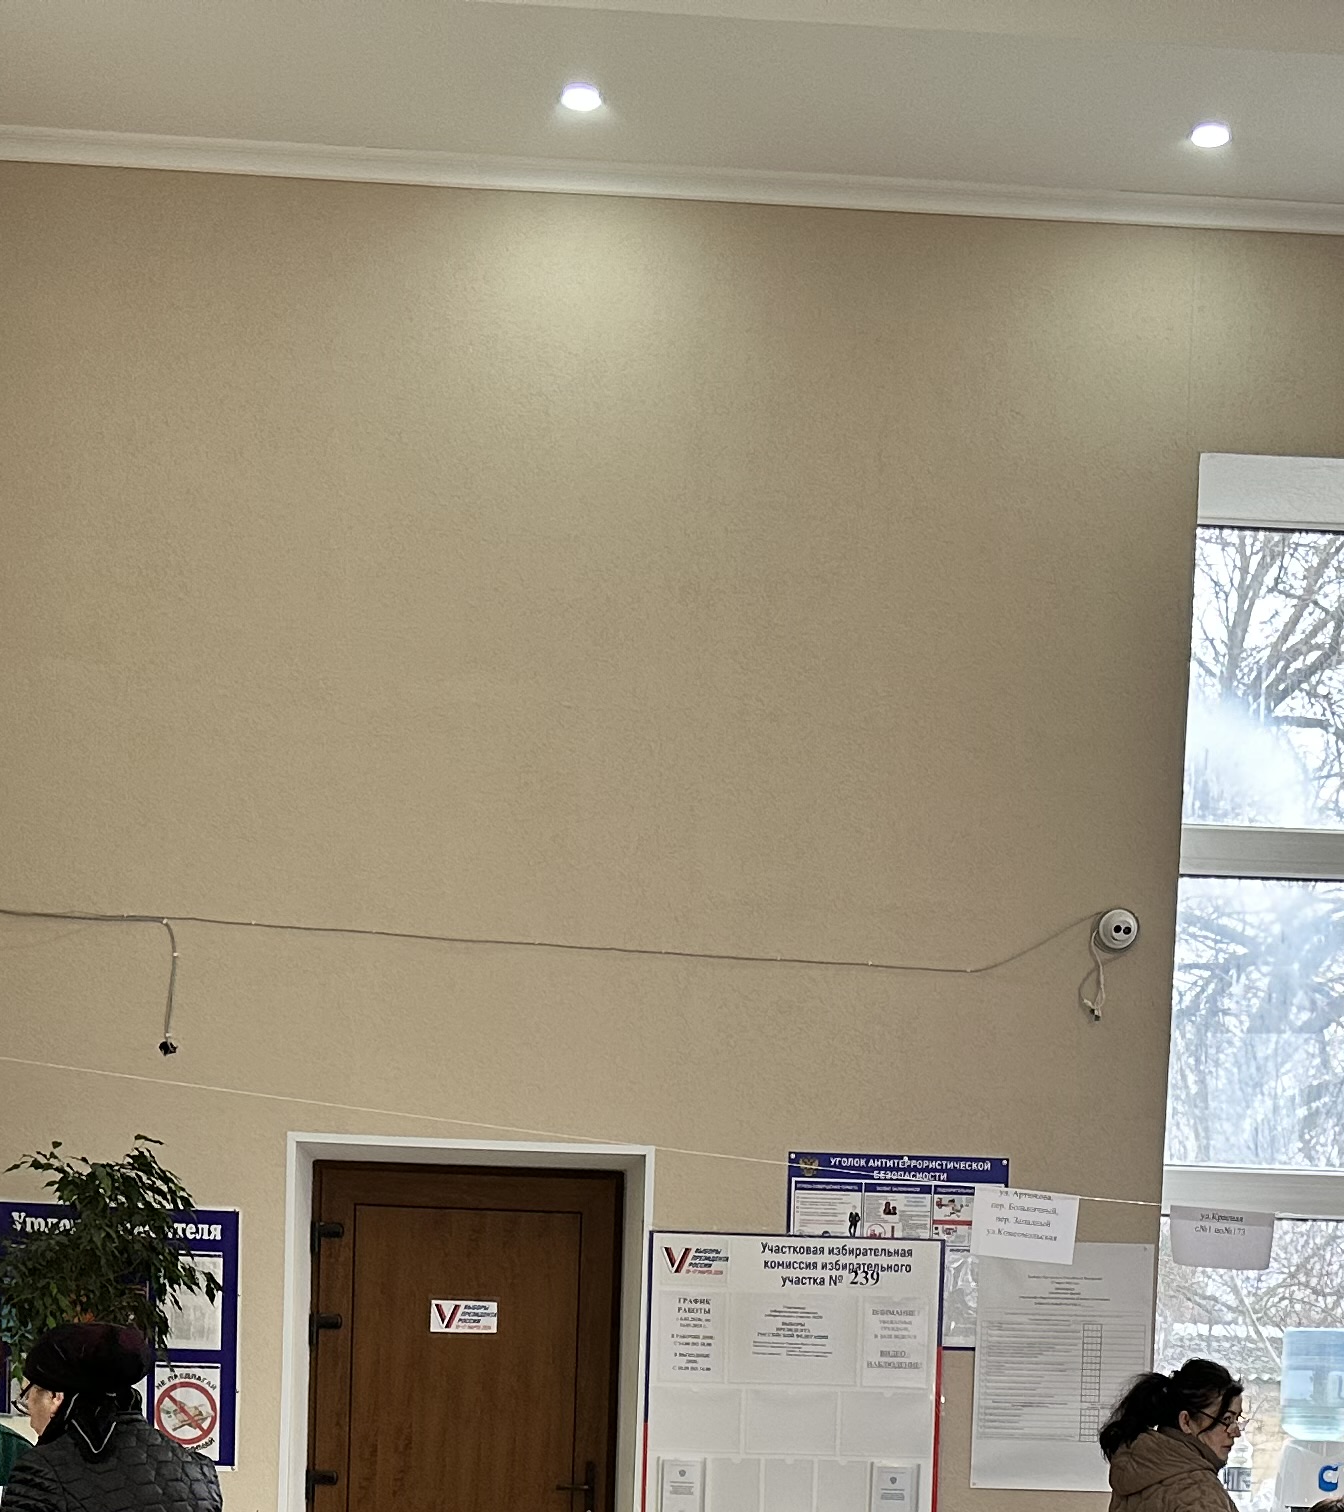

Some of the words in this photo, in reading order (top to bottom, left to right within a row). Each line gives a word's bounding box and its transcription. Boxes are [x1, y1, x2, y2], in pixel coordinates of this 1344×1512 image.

[829, 1157, 867, 1168] УГОЛОК
[868, 1158, 991, 1171] АНТИТЕРРОРИСТИЧЕСКОЙ
[760, 1241, 825, 1254] Участковая
[827, 1244, 913, 1259] избирательная
[763, 1259, 818, 1271] комиссия
[821, 1259, 912, 1274] избирательного
[781, 1275, 825, 1287] участка
[828, 1274, 844, 1287] №
[849, 1269, 880, 1287] 239
